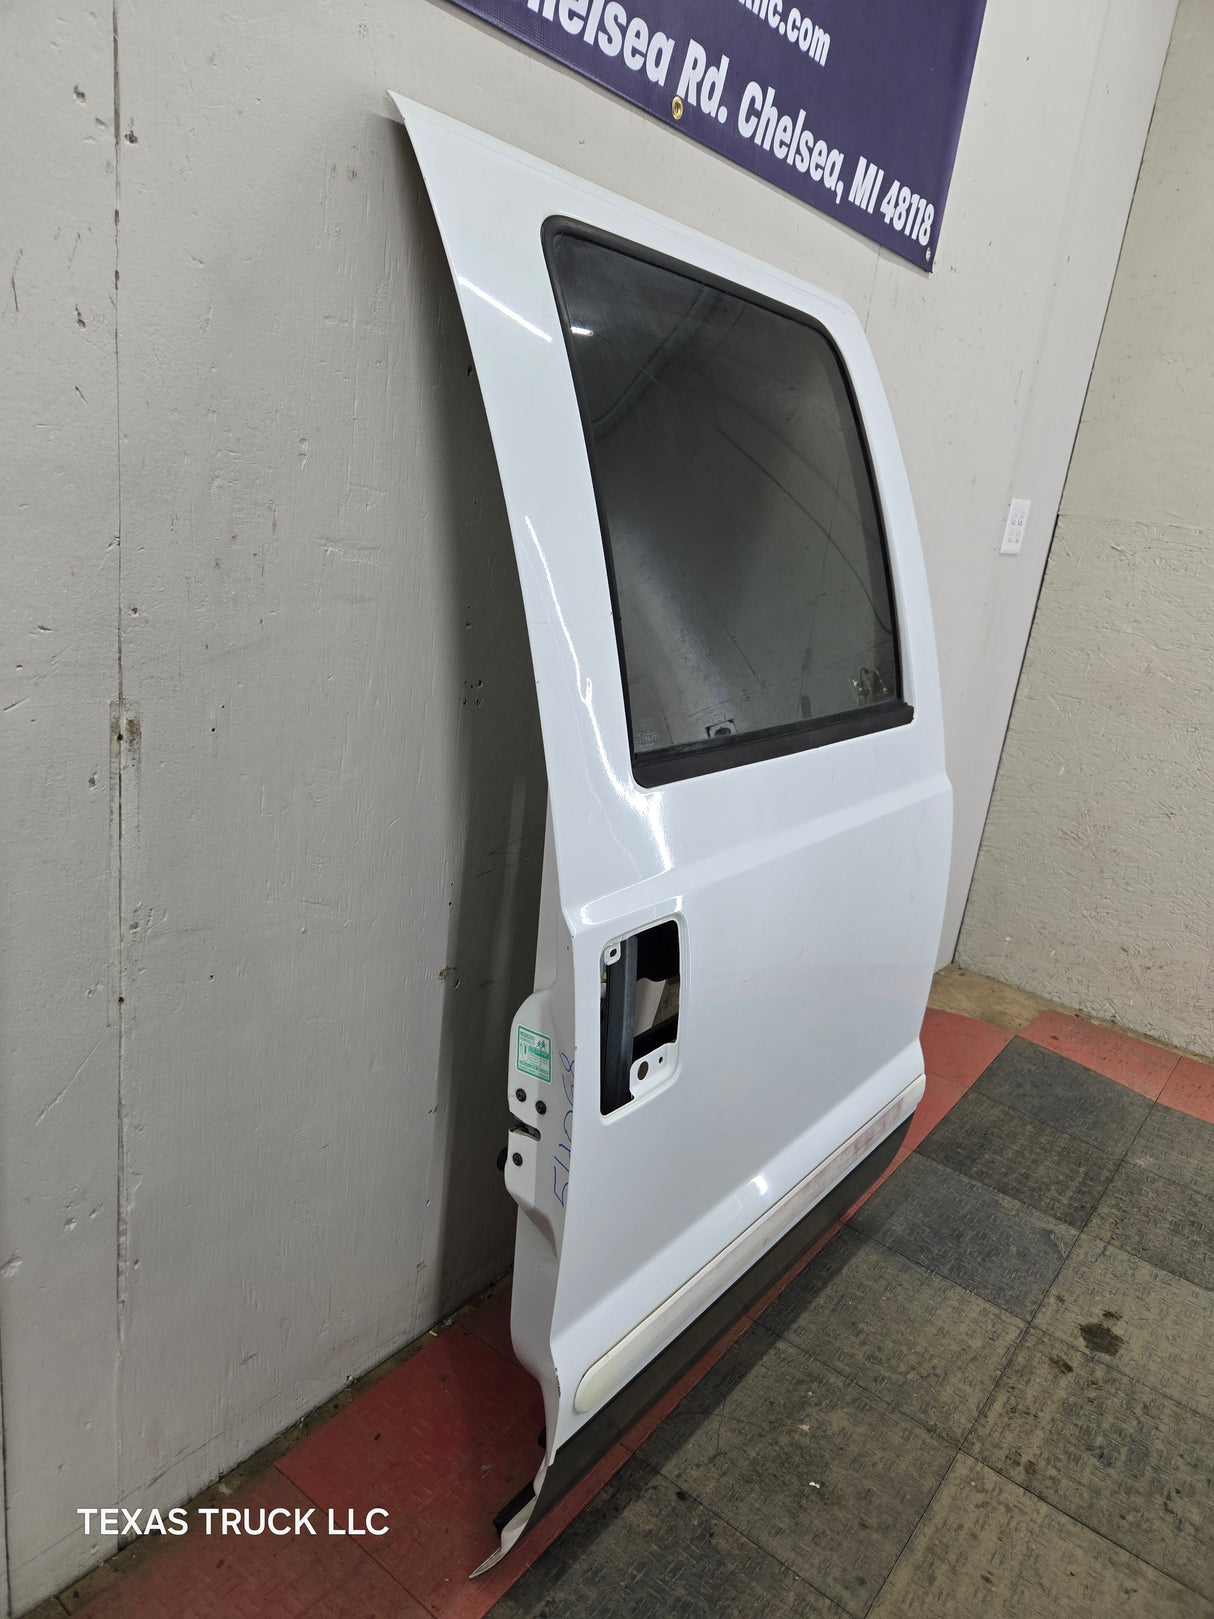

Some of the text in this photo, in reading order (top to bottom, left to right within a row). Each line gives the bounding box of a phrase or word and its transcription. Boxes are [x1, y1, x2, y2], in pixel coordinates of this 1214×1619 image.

[676, 39, 730, 124] Rd.
[737, 81, 845, 205] Chelsea,
[847, 155, 885, 215] MI
[879, 179, 935, 246] 48118
